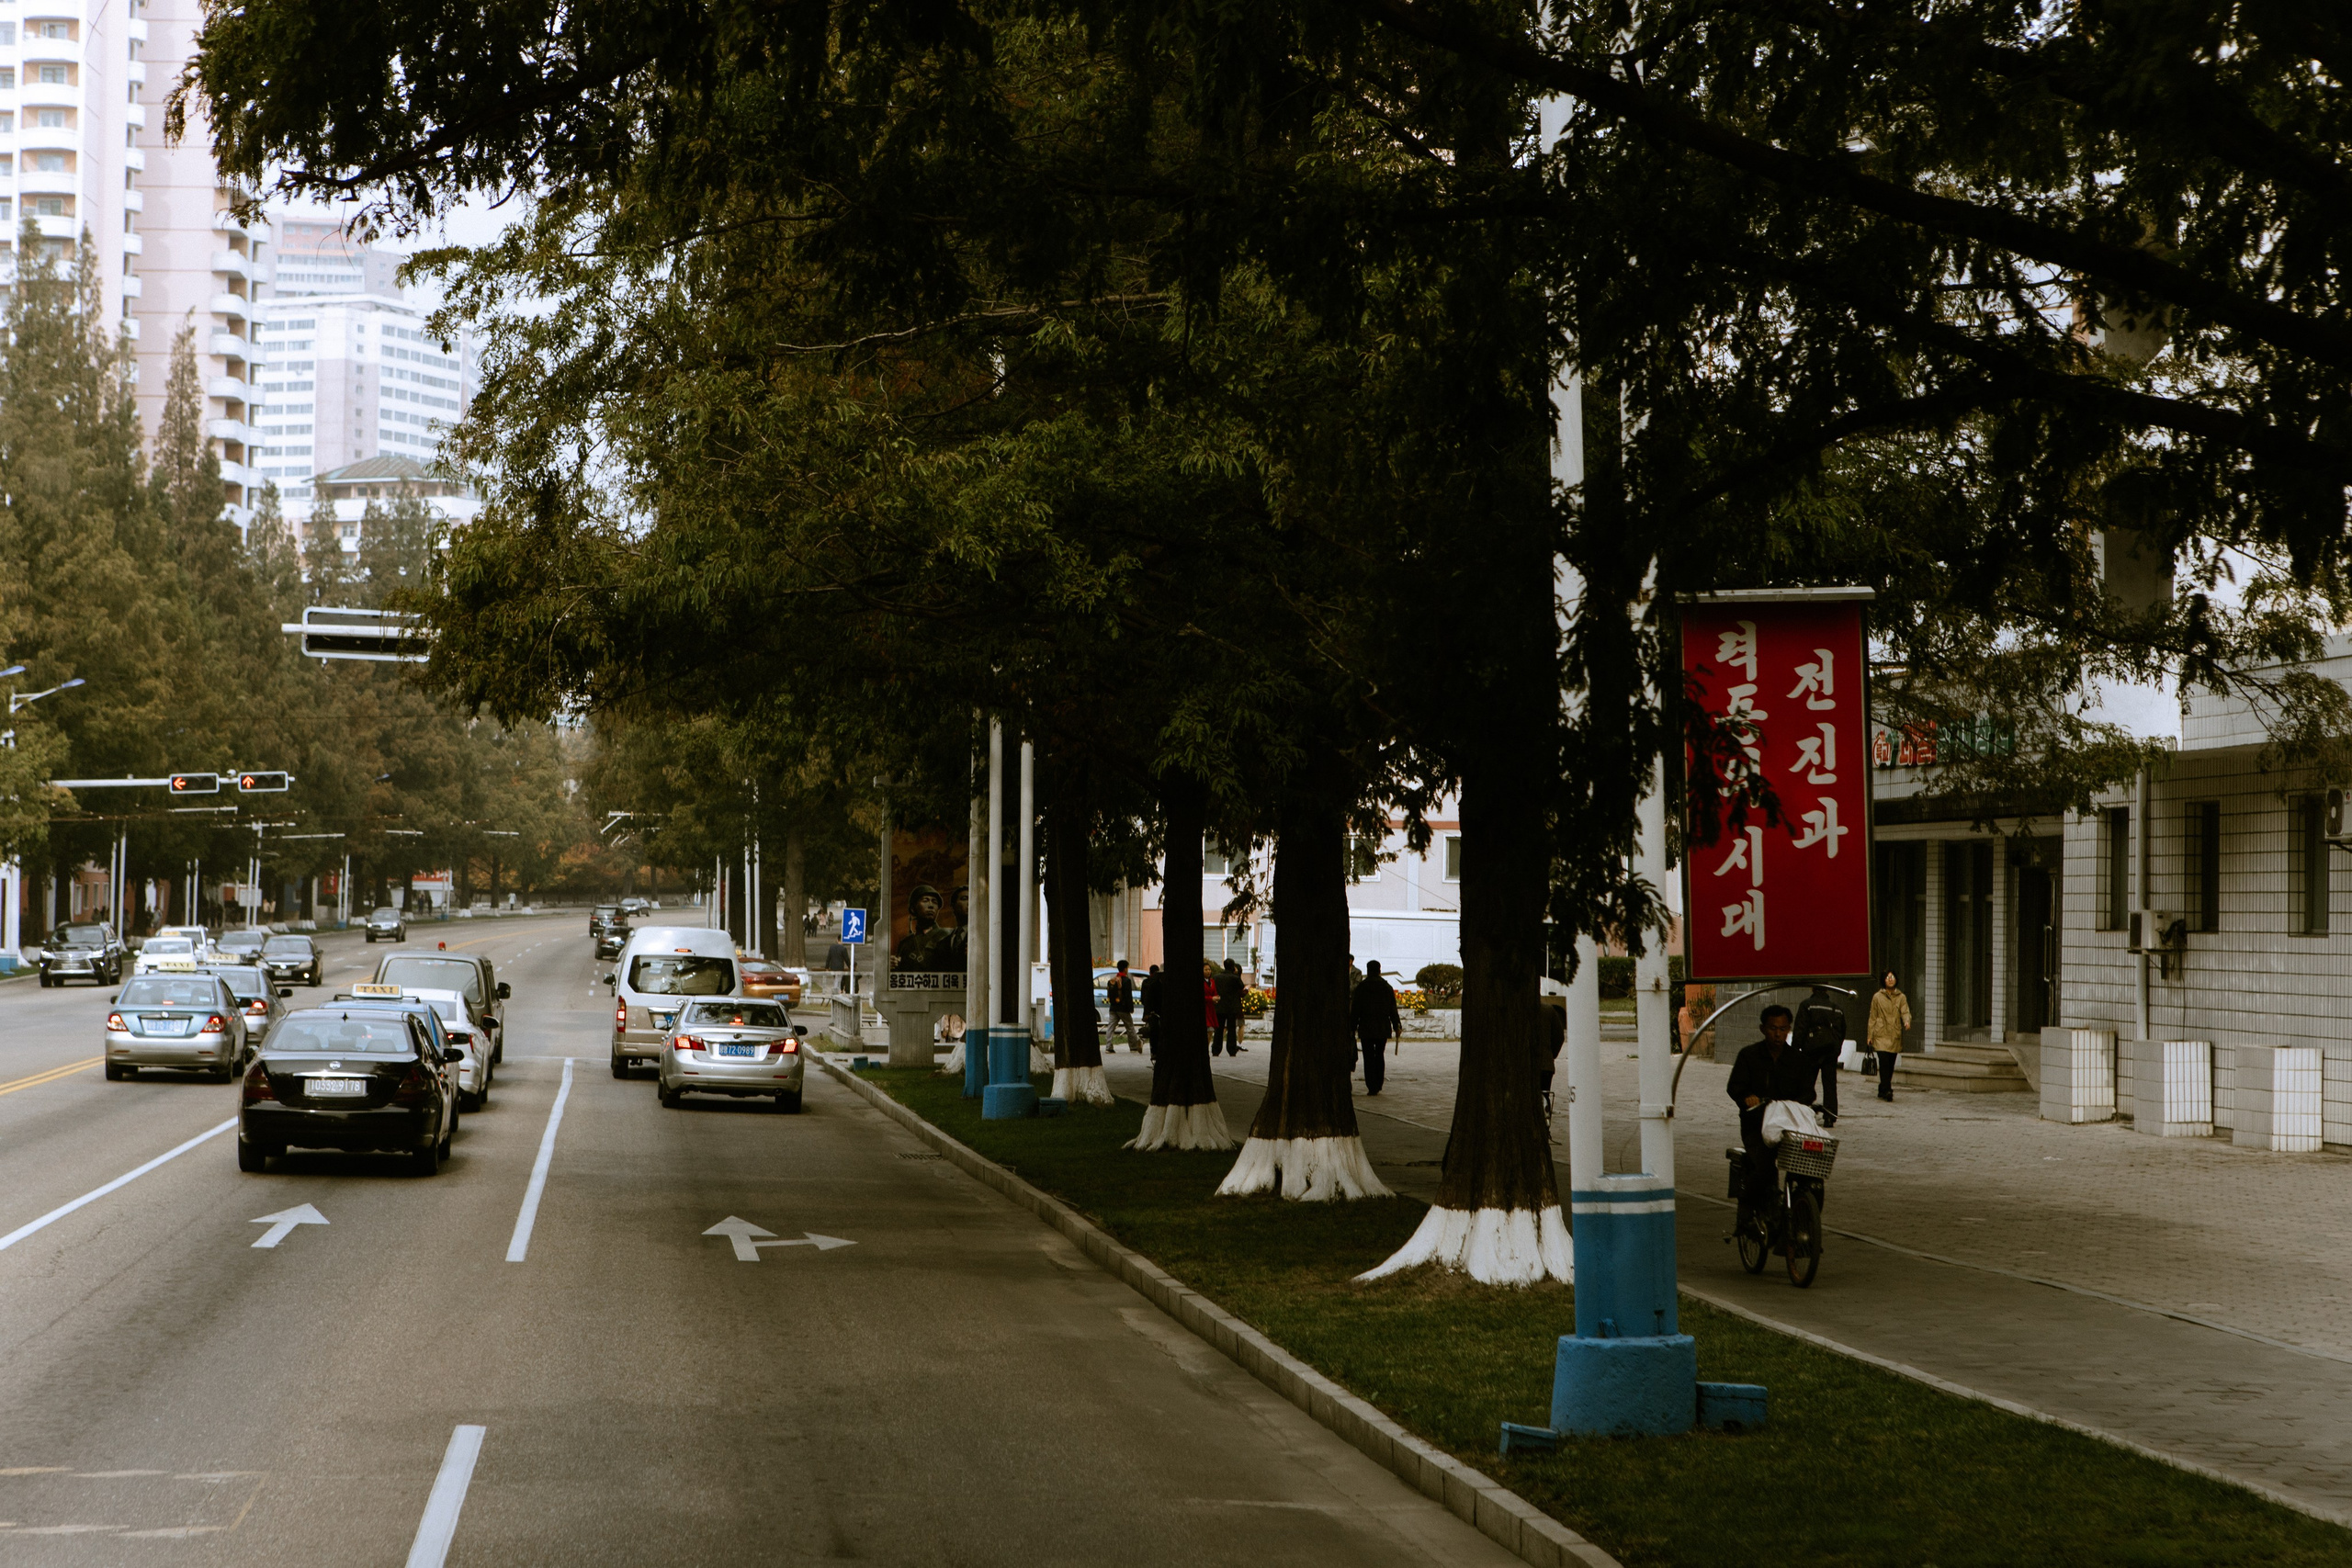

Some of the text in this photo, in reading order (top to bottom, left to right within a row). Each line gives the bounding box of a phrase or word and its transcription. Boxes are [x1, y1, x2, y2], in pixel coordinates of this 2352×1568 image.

[1786, 649, 1849, 859] 전진과
[1713, 826, 1766, 952] 시대
[360, 986, 393, 995] TAXI
[890, 974, 939, 988] 옹호고수하고
[943, 974, 959, 988] 더욱
